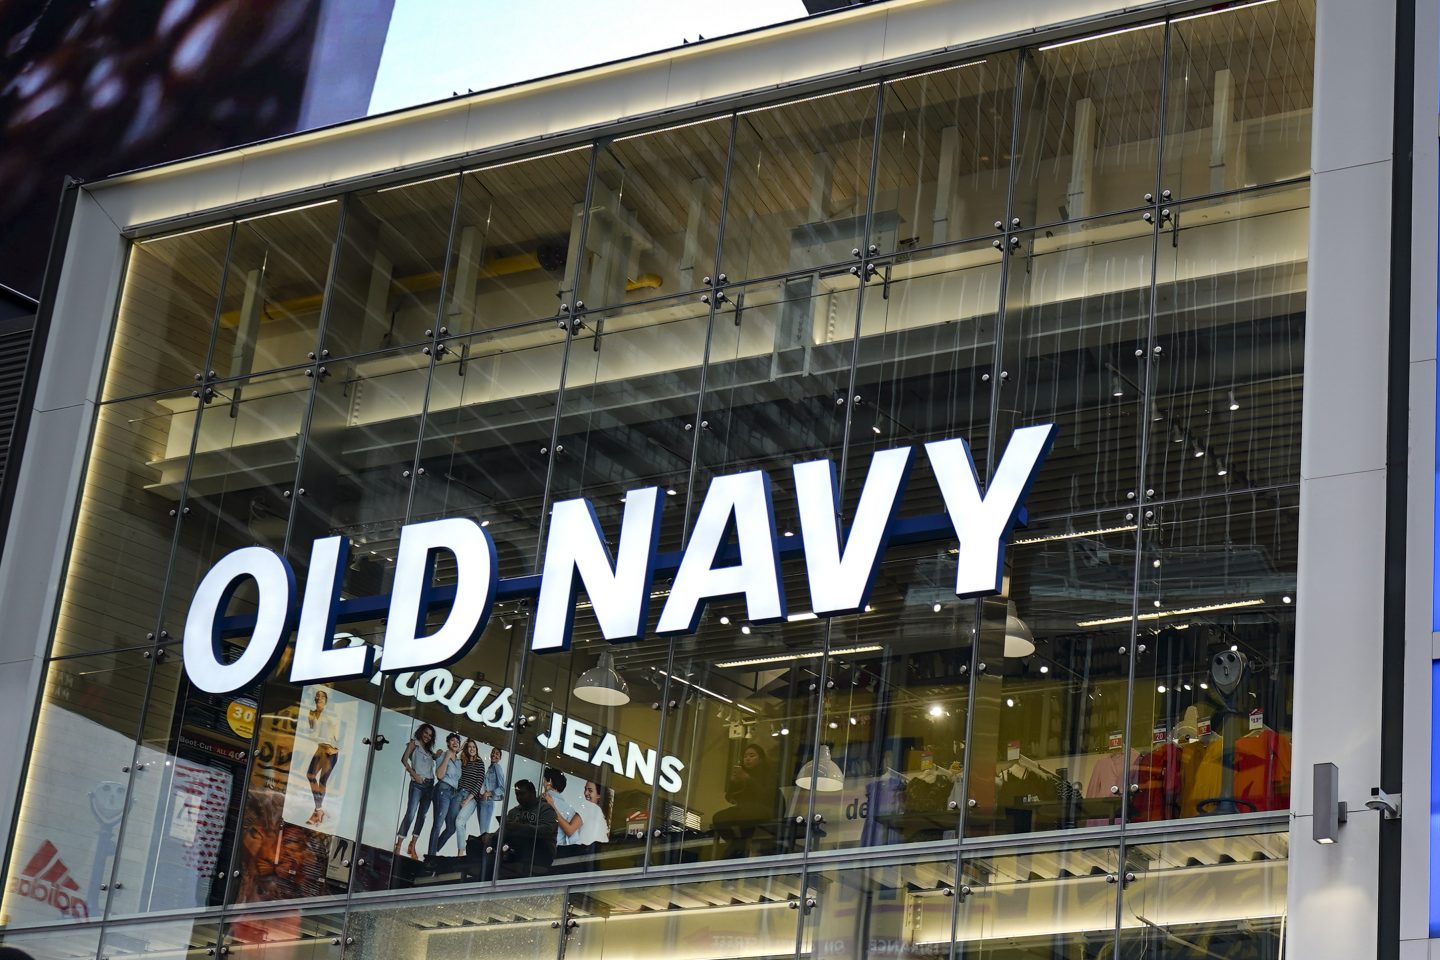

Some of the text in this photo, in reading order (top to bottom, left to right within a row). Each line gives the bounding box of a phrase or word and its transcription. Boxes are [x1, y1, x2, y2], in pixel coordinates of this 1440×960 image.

[183, 423, 1058, 695] OLD NAVY
[536, 712, 686, 794] JEANS
